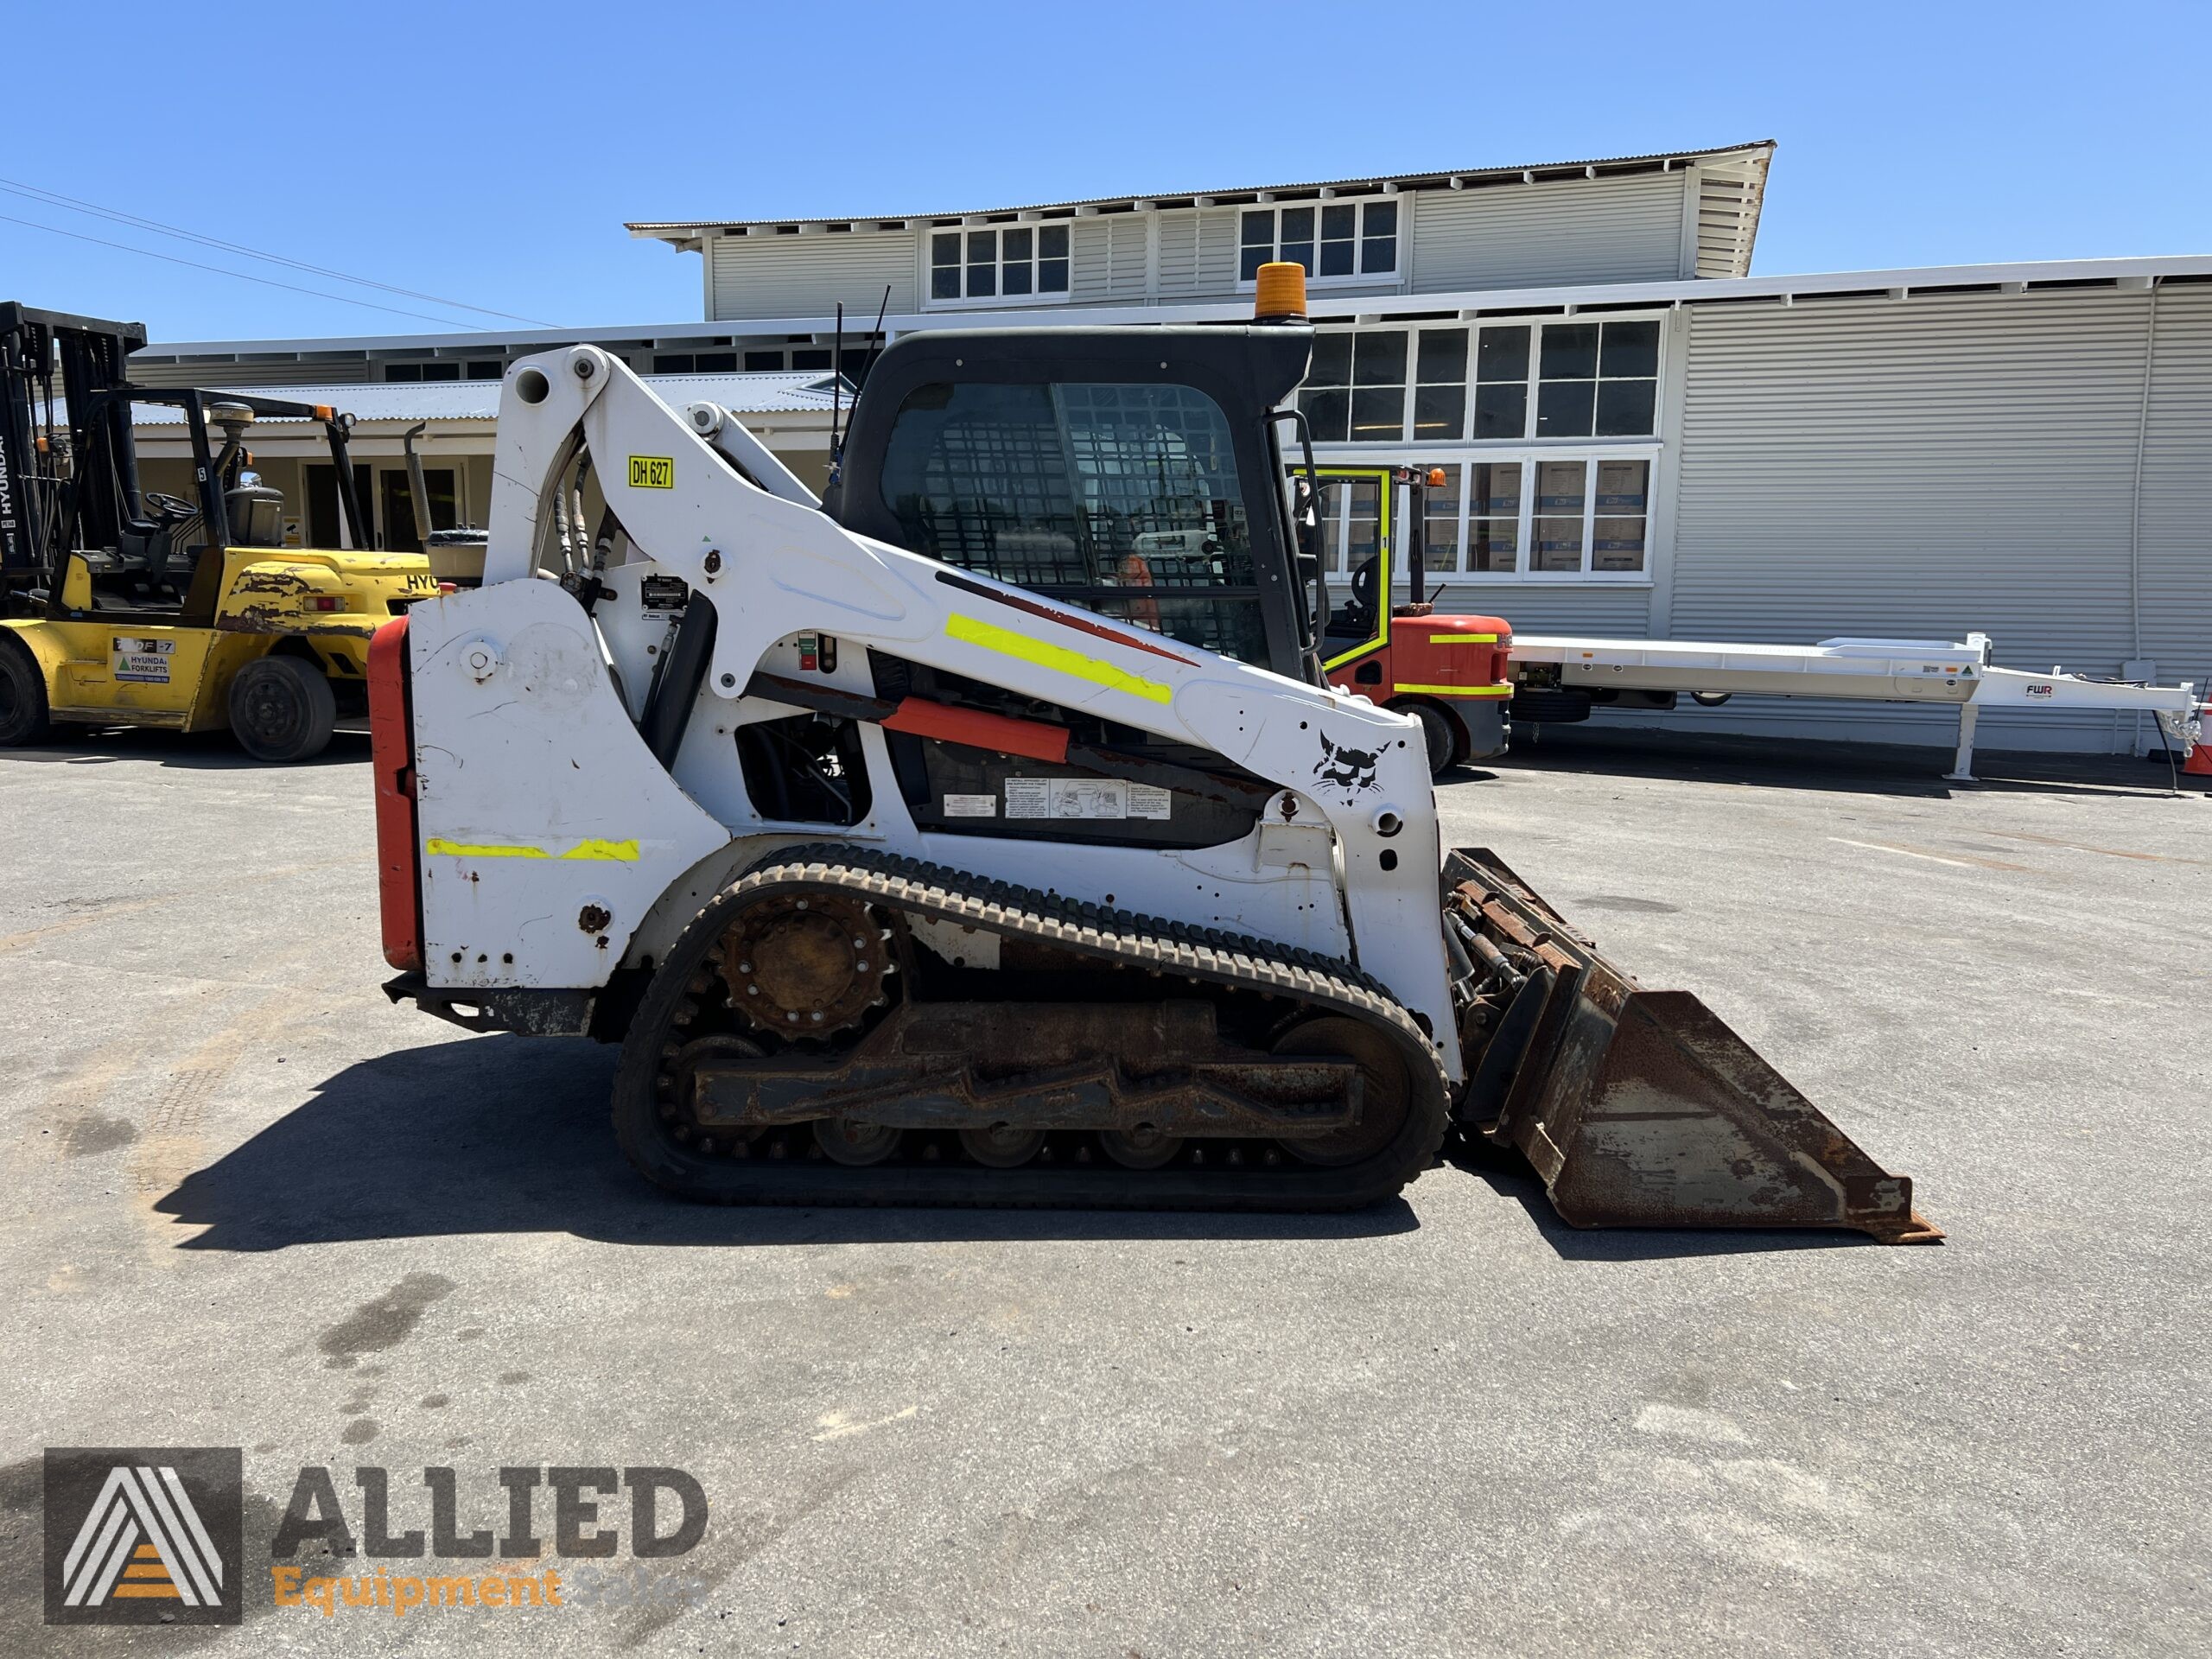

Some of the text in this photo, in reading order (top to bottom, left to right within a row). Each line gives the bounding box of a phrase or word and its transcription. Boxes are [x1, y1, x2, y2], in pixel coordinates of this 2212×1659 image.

[199, 468, 206, 480] 5
[633, 461, 669, 486] DH 627
[131, 664, 168, 673] FORKLIFTS
[2026, 685, 2052, 695] FWR
